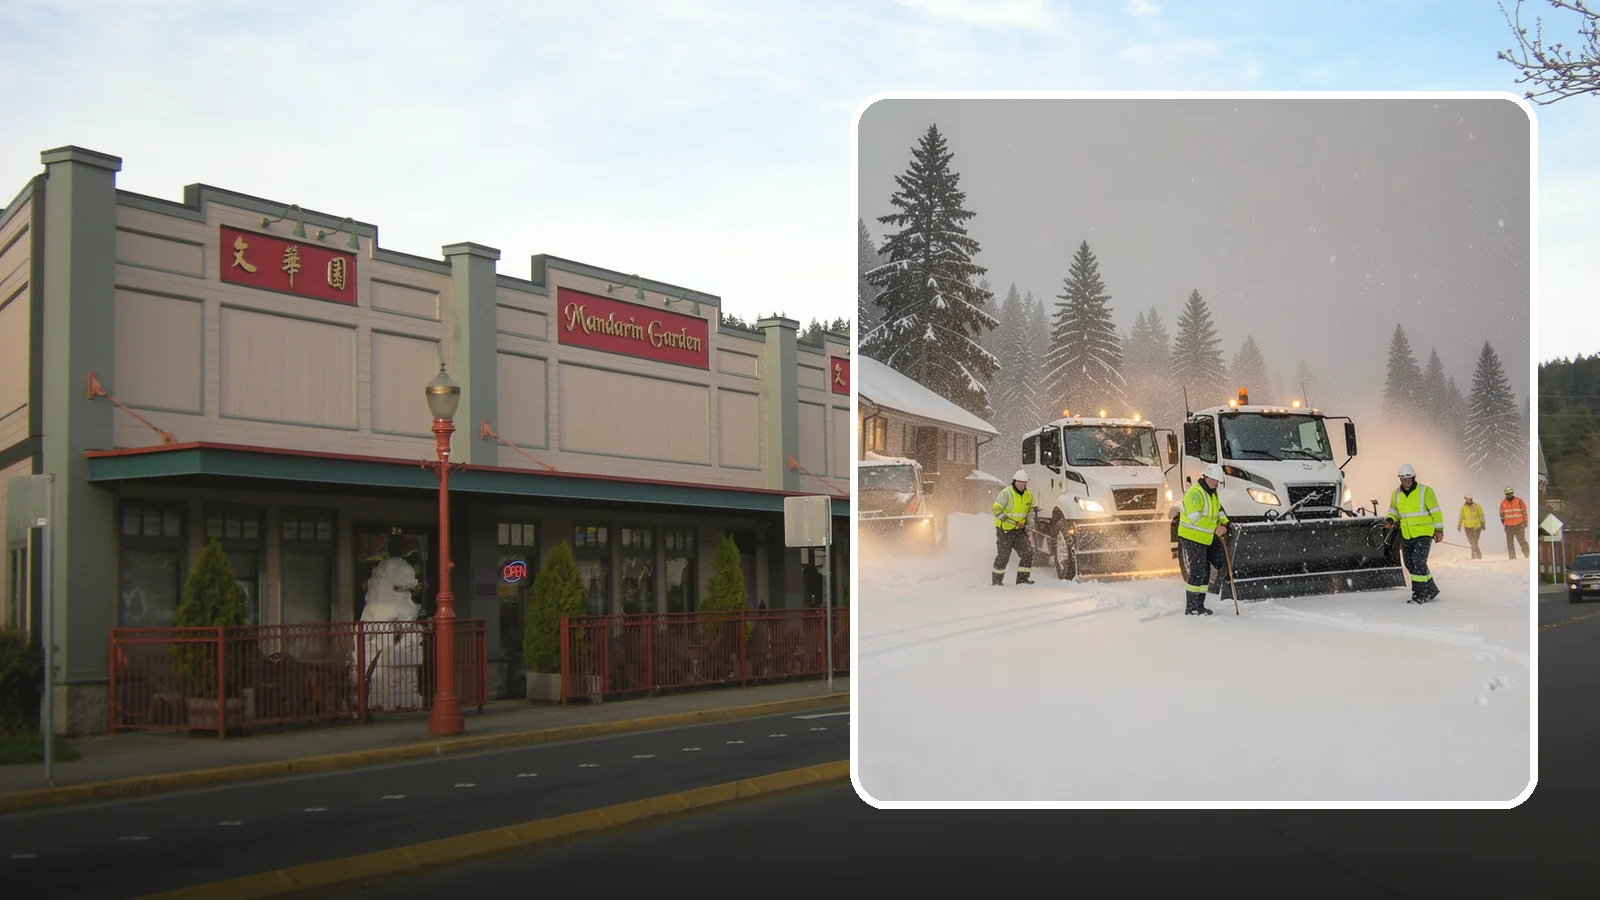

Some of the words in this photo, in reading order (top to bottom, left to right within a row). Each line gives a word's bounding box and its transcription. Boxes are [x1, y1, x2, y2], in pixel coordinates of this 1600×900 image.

[564, 302, 644, 341] Mandarin
[647, 320, 702, 352] Garden
[503, 565, 527, 578] OPEN
